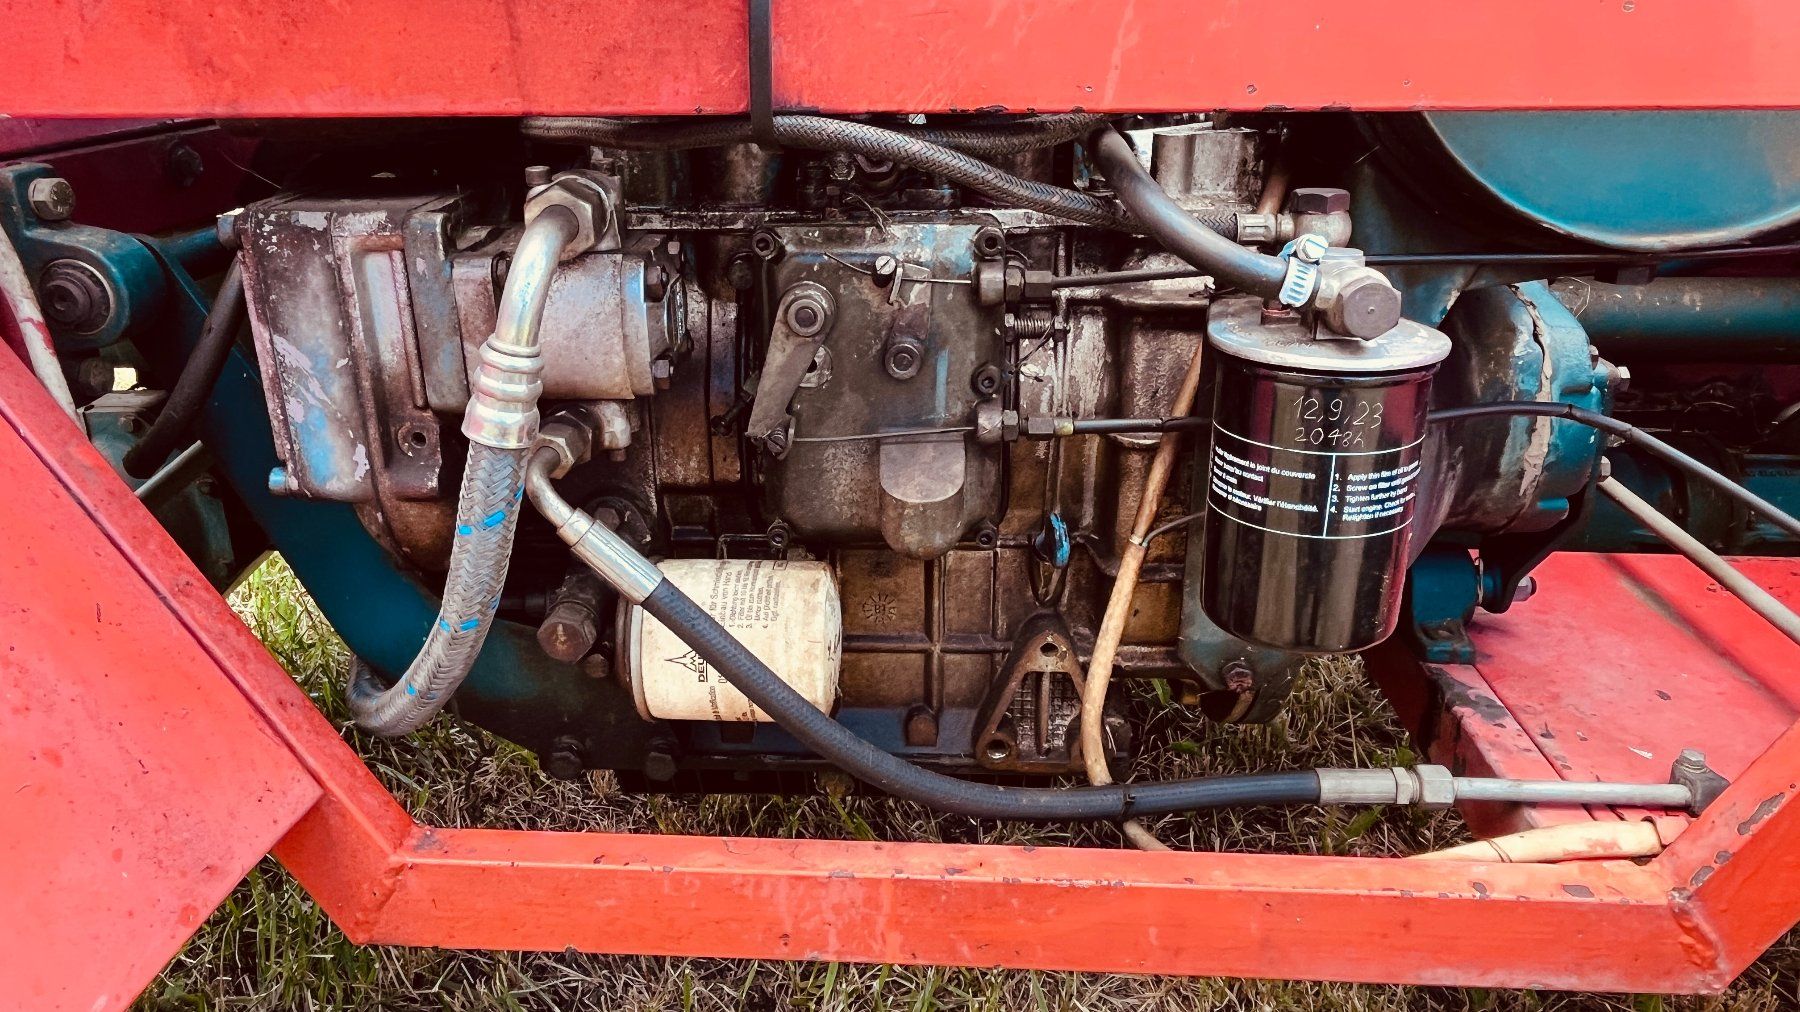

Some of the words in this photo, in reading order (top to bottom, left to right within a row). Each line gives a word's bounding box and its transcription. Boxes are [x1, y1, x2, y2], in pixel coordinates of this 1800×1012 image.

[1256, 463, 1271, 473] joint
[1271, 467, 1281, 475] du
[1281, 470, 1317, 480] couvercle
[1334, 473, 1342, 481] 1.
[1347, 473, 1368, 482] Apply
[1368, 472, 1380, 480] thin
[1332, 484, 1341, 492] 2.
[1346, 484, 1368, 492] Screw
[1331, 495, 1339, 503] 3.
[1345, 495, 1370, 503] Tighten
[1343, 506, 1361, 514] Start
[1342, 513, 1374, 522] Retighten
[698, 657, 706, 683] DEU
